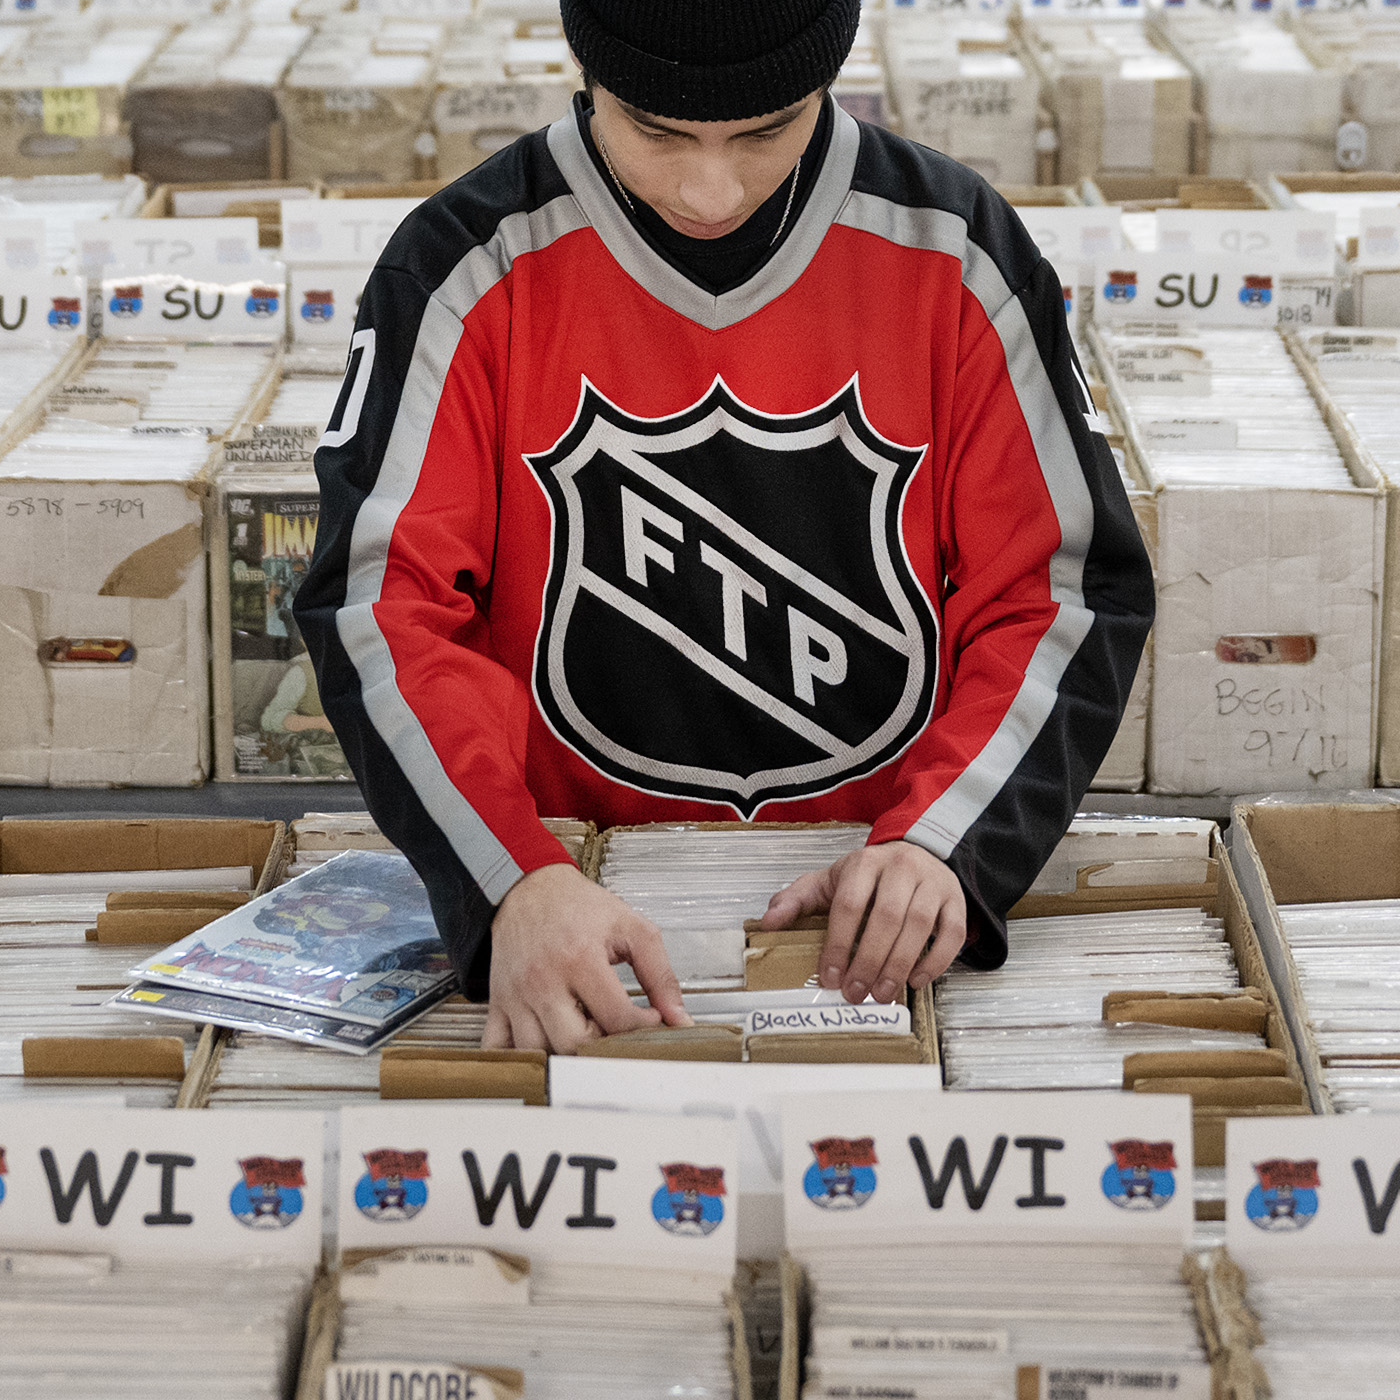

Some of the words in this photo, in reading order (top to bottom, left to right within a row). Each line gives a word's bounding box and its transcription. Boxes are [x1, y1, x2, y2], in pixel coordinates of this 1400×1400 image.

[161, 289, 225, 322] SU
[1154, 273, 1220, 309] SU
[224, 437, 304, 451] SUPERMAN
[279, 502, 320, 514] SUPER
[261, 511, 318, 558] JIMM
[619, 484, 851, 708] FTP
[1215, 678, 1325, 716] BEGIN
[751, 1011, 817, 1032] Black
[820, 1008, 900, 1028] Widow
[39, 1146, 196, 1229] WI
[461, 1150, 618, 1230] WI
[908, 1134, 1067, 1211] WI
